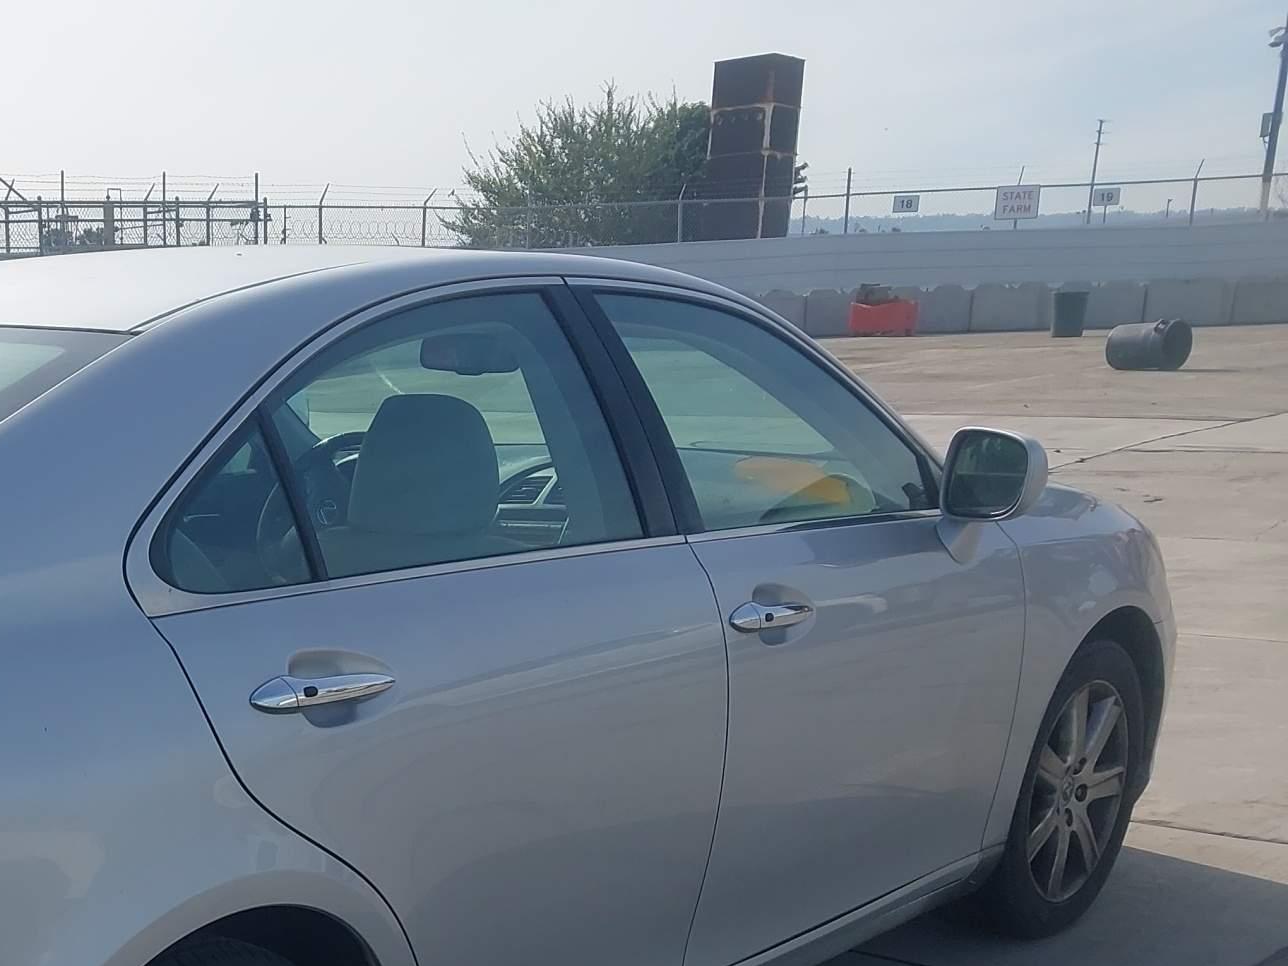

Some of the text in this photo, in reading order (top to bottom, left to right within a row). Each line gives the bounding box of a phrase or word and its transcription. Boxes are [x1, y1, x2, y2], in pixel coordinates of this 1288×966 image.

[1001, 190, 1034, 201] STATE
[1100, 192, 1114, 202] 19
[899, 199, 913, 209] 18
[1002, 204, 1032, 214] FARM
